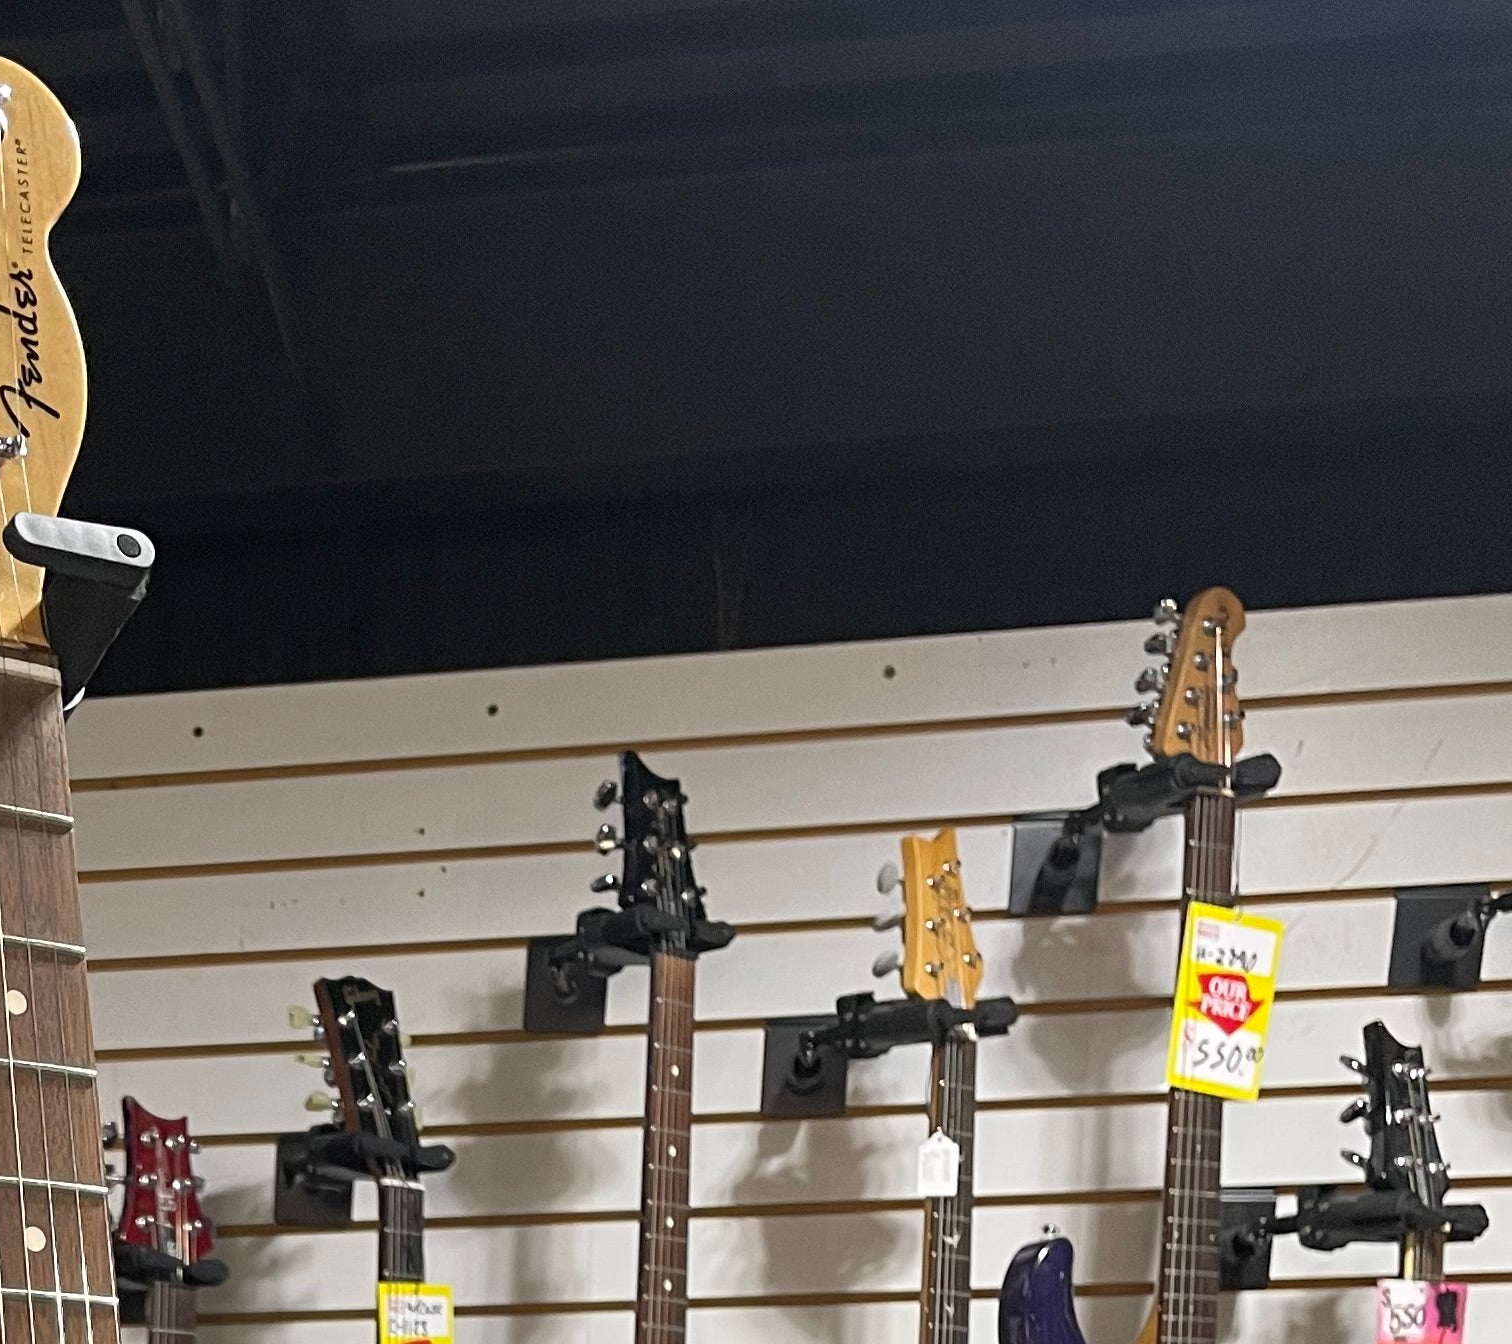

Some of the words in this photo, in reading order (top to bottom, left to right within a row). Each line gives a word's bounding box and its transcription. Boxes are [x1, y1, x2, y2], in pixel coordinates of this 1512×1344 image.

[17, 151, 34, 255] TELECASTER
[1208, 975, 1248, 998] OUR
[1200, 993, 1253, 1023] PRICE
